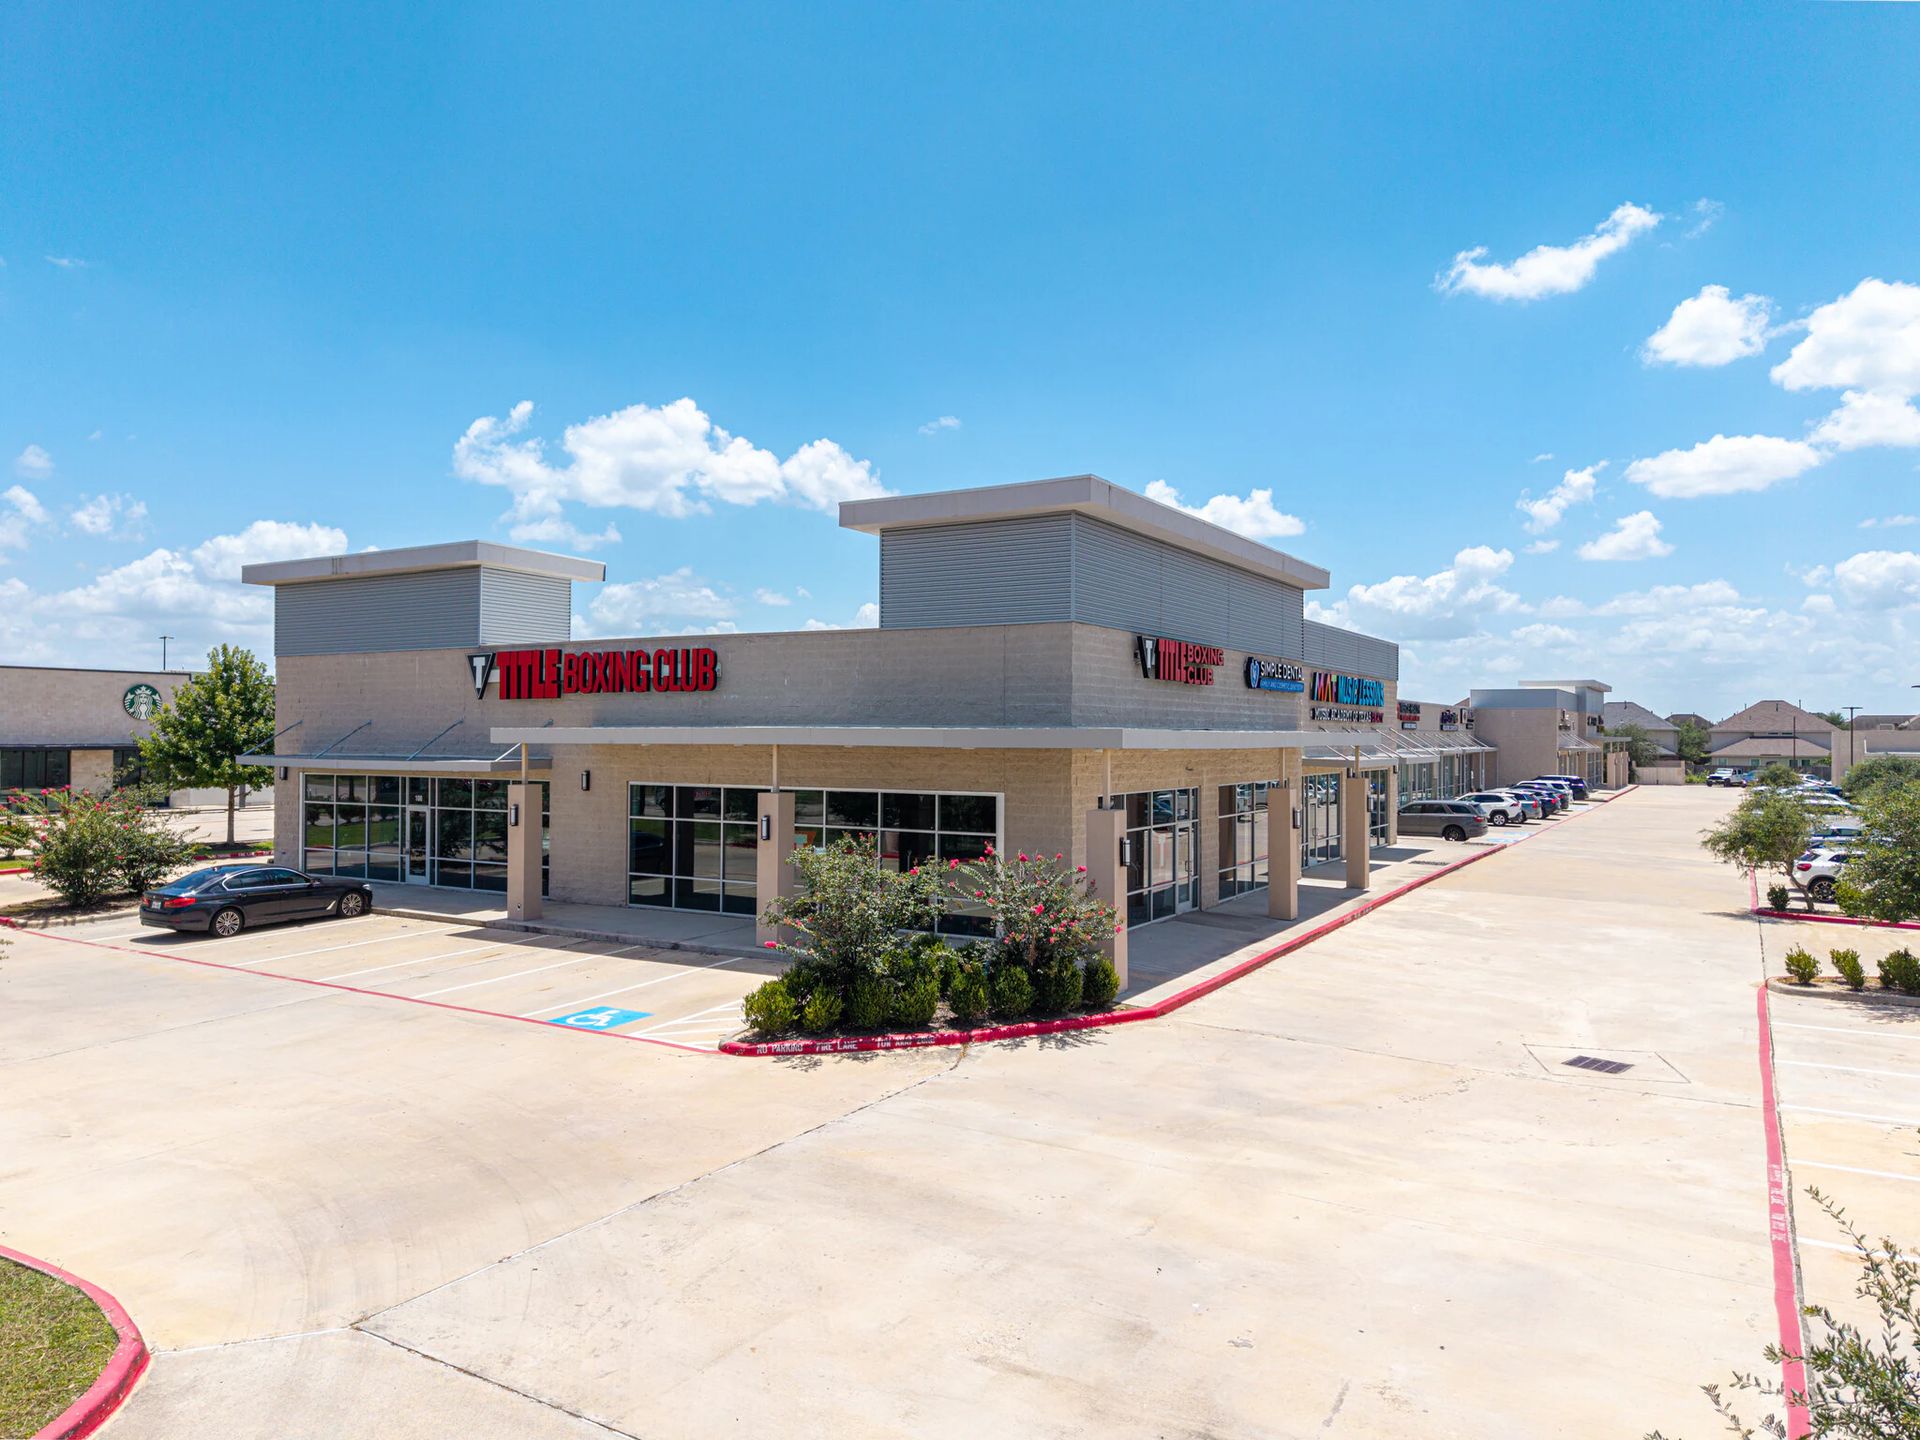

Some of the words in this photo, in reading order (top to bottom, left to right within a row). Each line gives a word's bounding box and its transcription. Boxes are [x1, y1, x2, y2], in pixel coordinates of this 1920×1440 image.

[1158, 639, 1187, 682] TITLE
[1187, 645, 1225, 666] BOXING
[1260, 661, 1282, 678] SIMPLE
[496, 649, 562, 700] TITLE
[562, 649, 650, 694] BOXING
[652, 648, 718, 693] CLUB
[1187, 666, 1214, 686] CLUB
[1337, 674, 1359, 704] MUSIC
[771, 1041, 803, 1053] PARKING
[815, 1040, 834, 1051] FIRE
[837, 1039, 858, 1050] LANE
